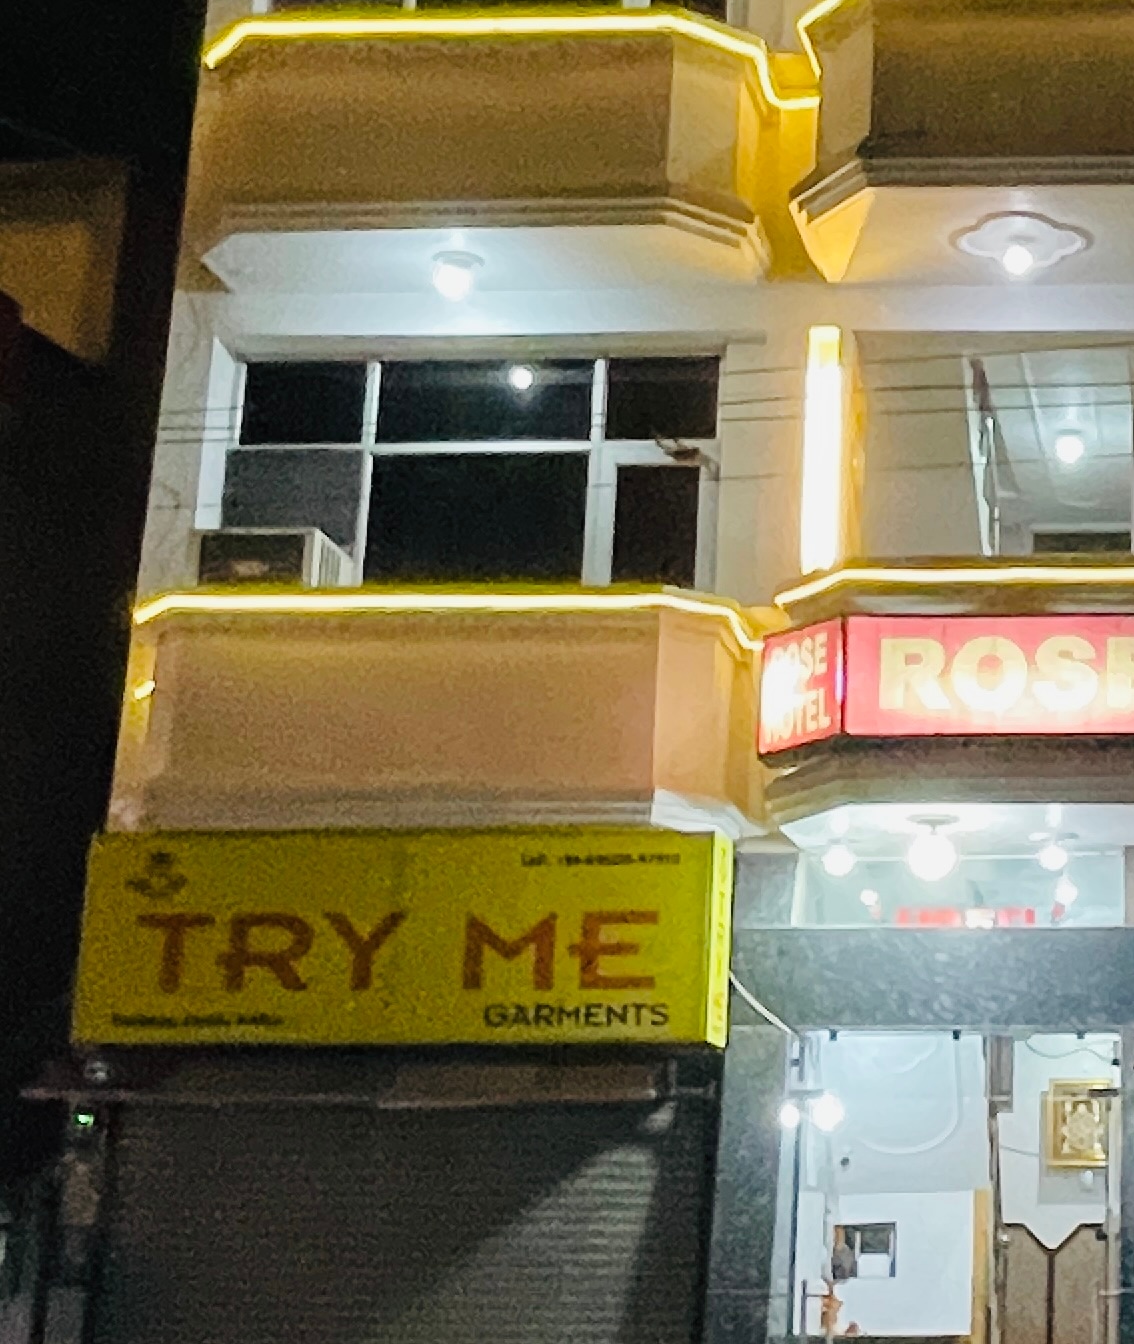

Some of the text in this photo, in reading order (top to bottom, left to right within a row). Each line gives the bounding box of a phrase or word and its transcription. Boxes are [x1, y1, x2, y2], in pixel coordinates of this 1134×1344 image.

[137, 910, 407, 994] TRY
[461, 910, 661, 991] ME
[484, 1003, 669, 1029] GARMENTS
